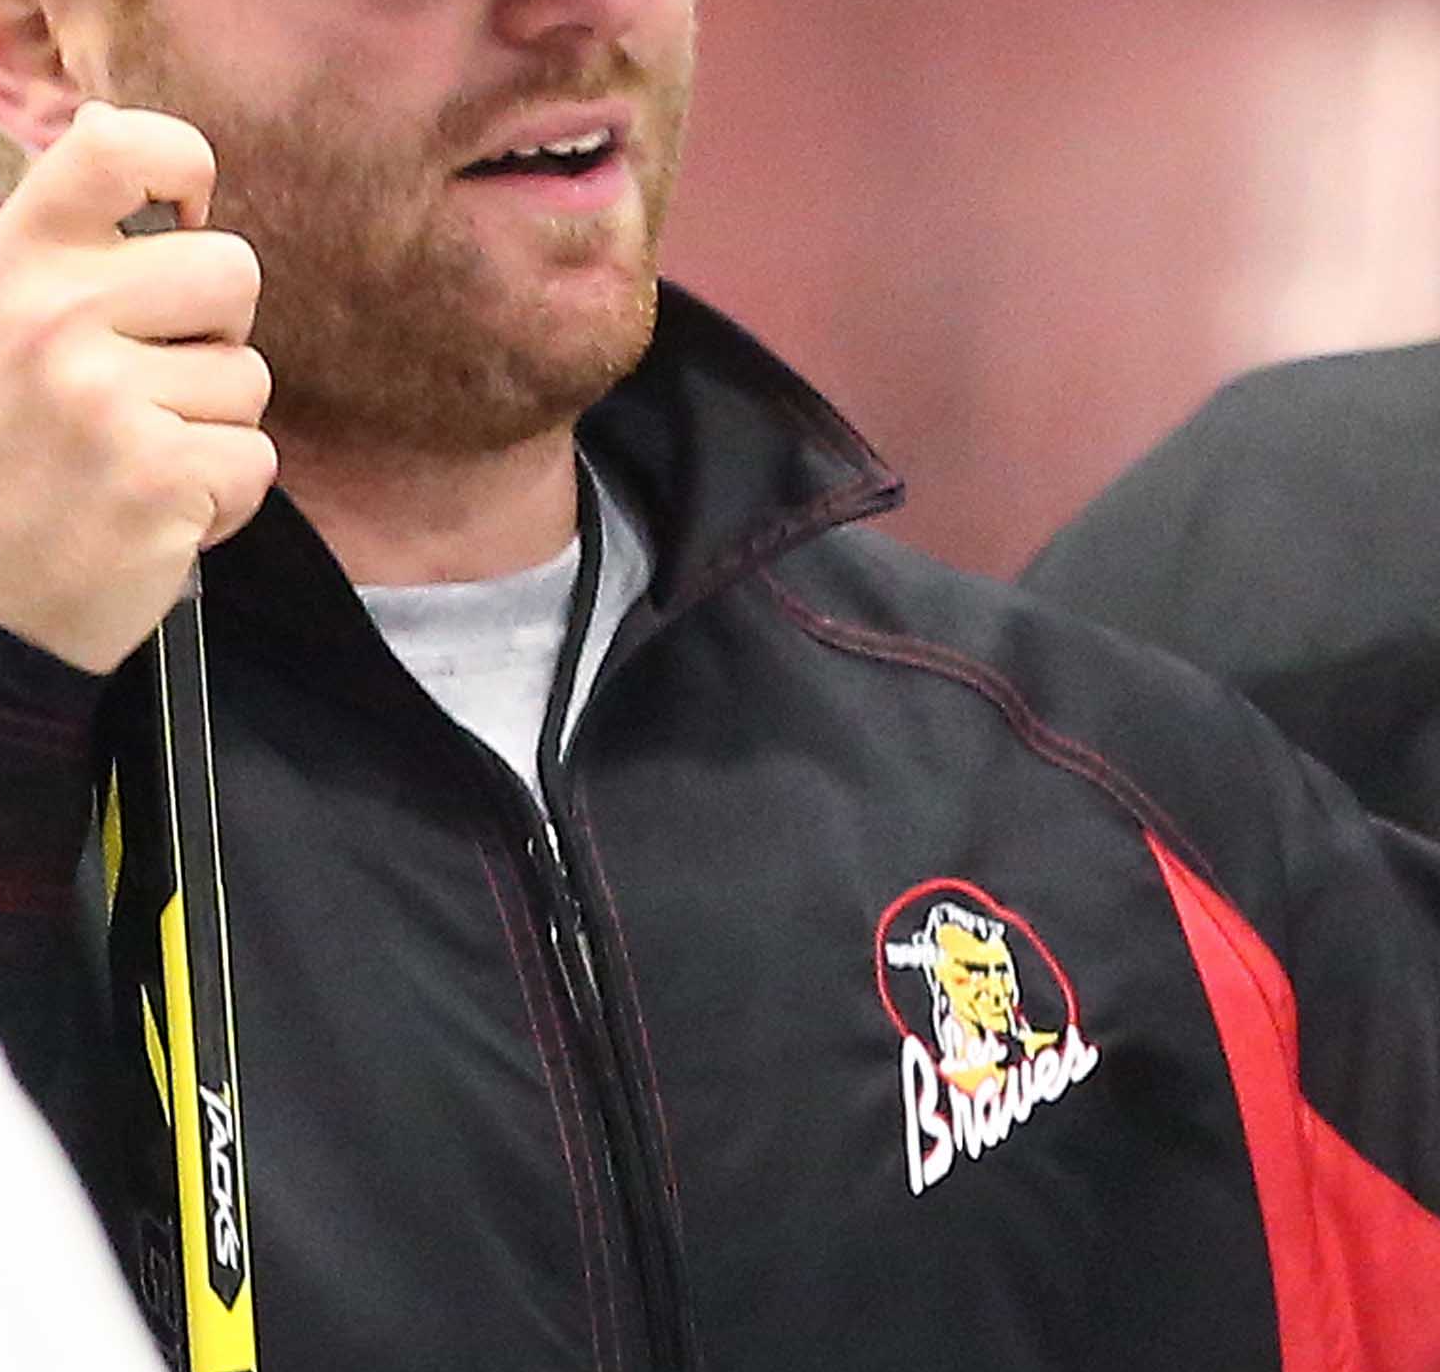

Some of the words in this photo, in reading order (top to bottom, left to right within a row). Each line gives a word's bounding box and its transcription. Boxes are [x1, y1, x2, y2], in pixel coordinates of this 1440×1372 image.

[902, 1024, 1099, 1196] Braves
[939, 1013, 1008, 1070] Les
[199, 1081, 241, 1270] TACKS
